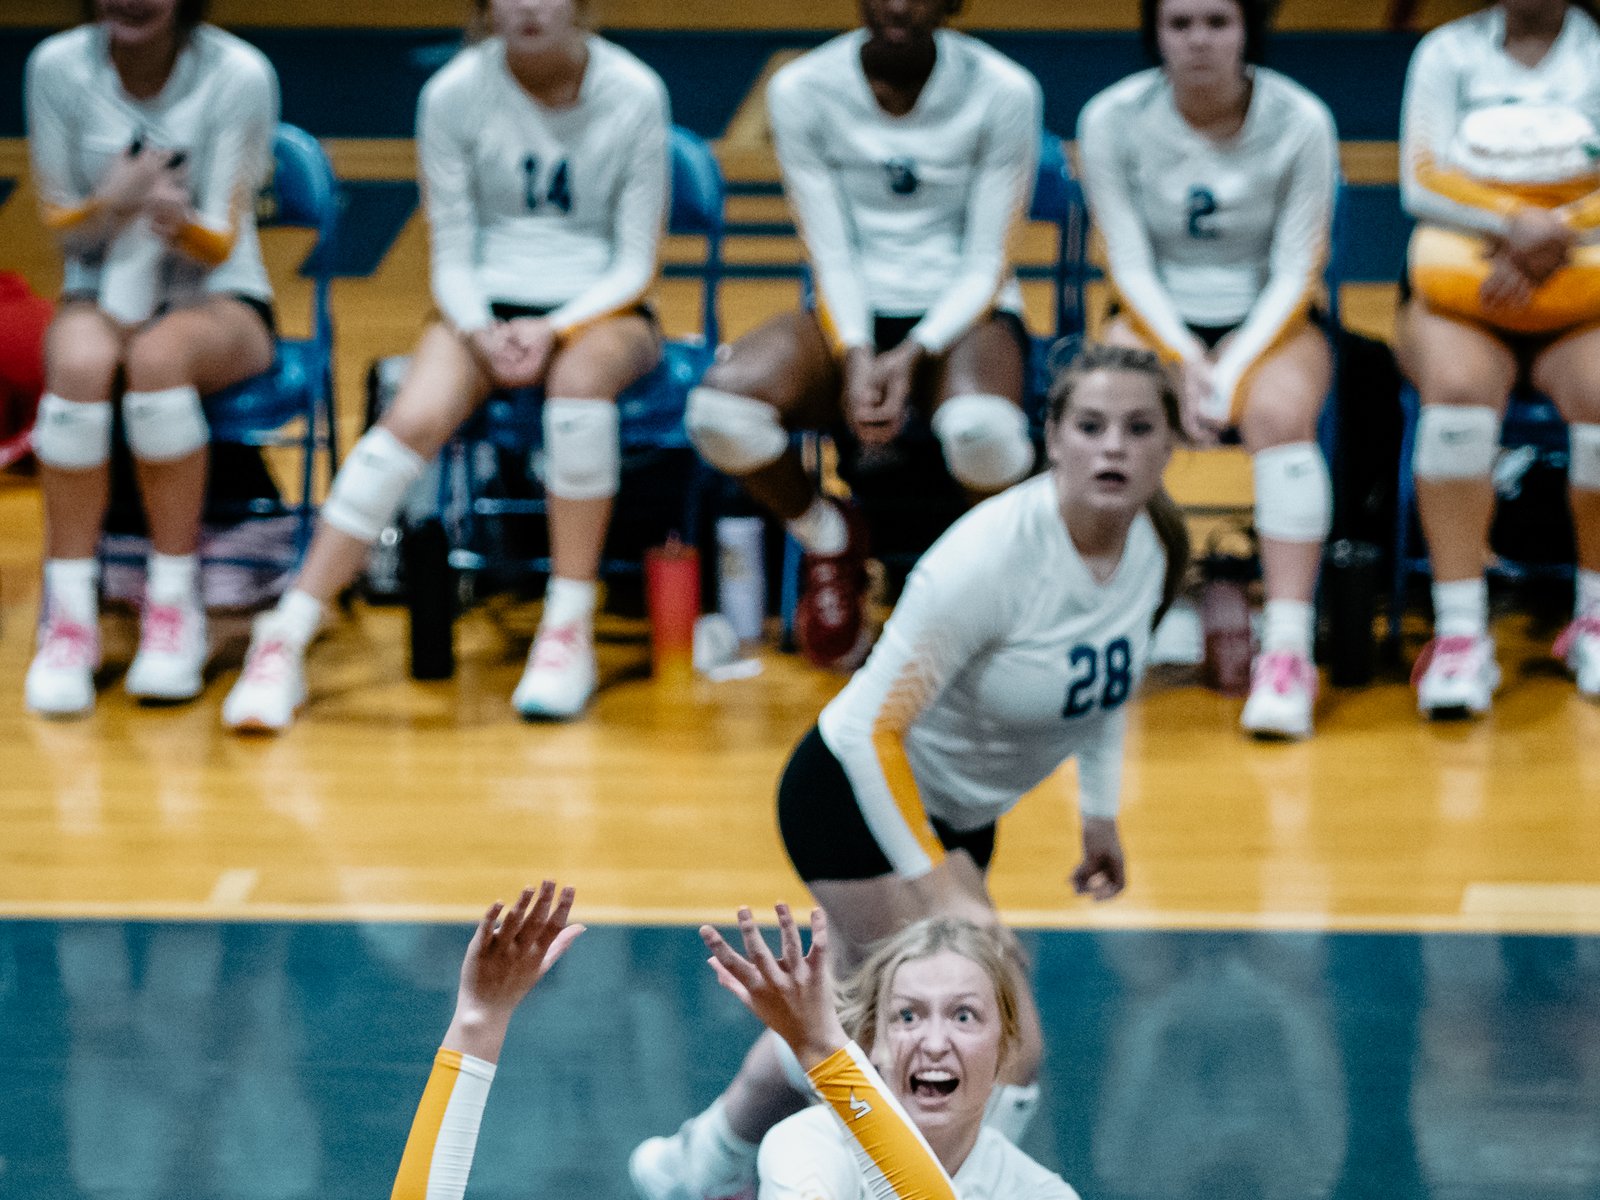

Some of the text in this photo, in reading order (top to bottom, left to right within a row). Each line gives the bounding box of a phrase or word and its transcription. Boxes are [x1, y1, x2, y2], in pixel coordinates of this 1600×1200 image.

[522, 153, 572, 213] 14
[1187, 187, 1217, 239] 2
[1063, 638, 1130, 717] 28
